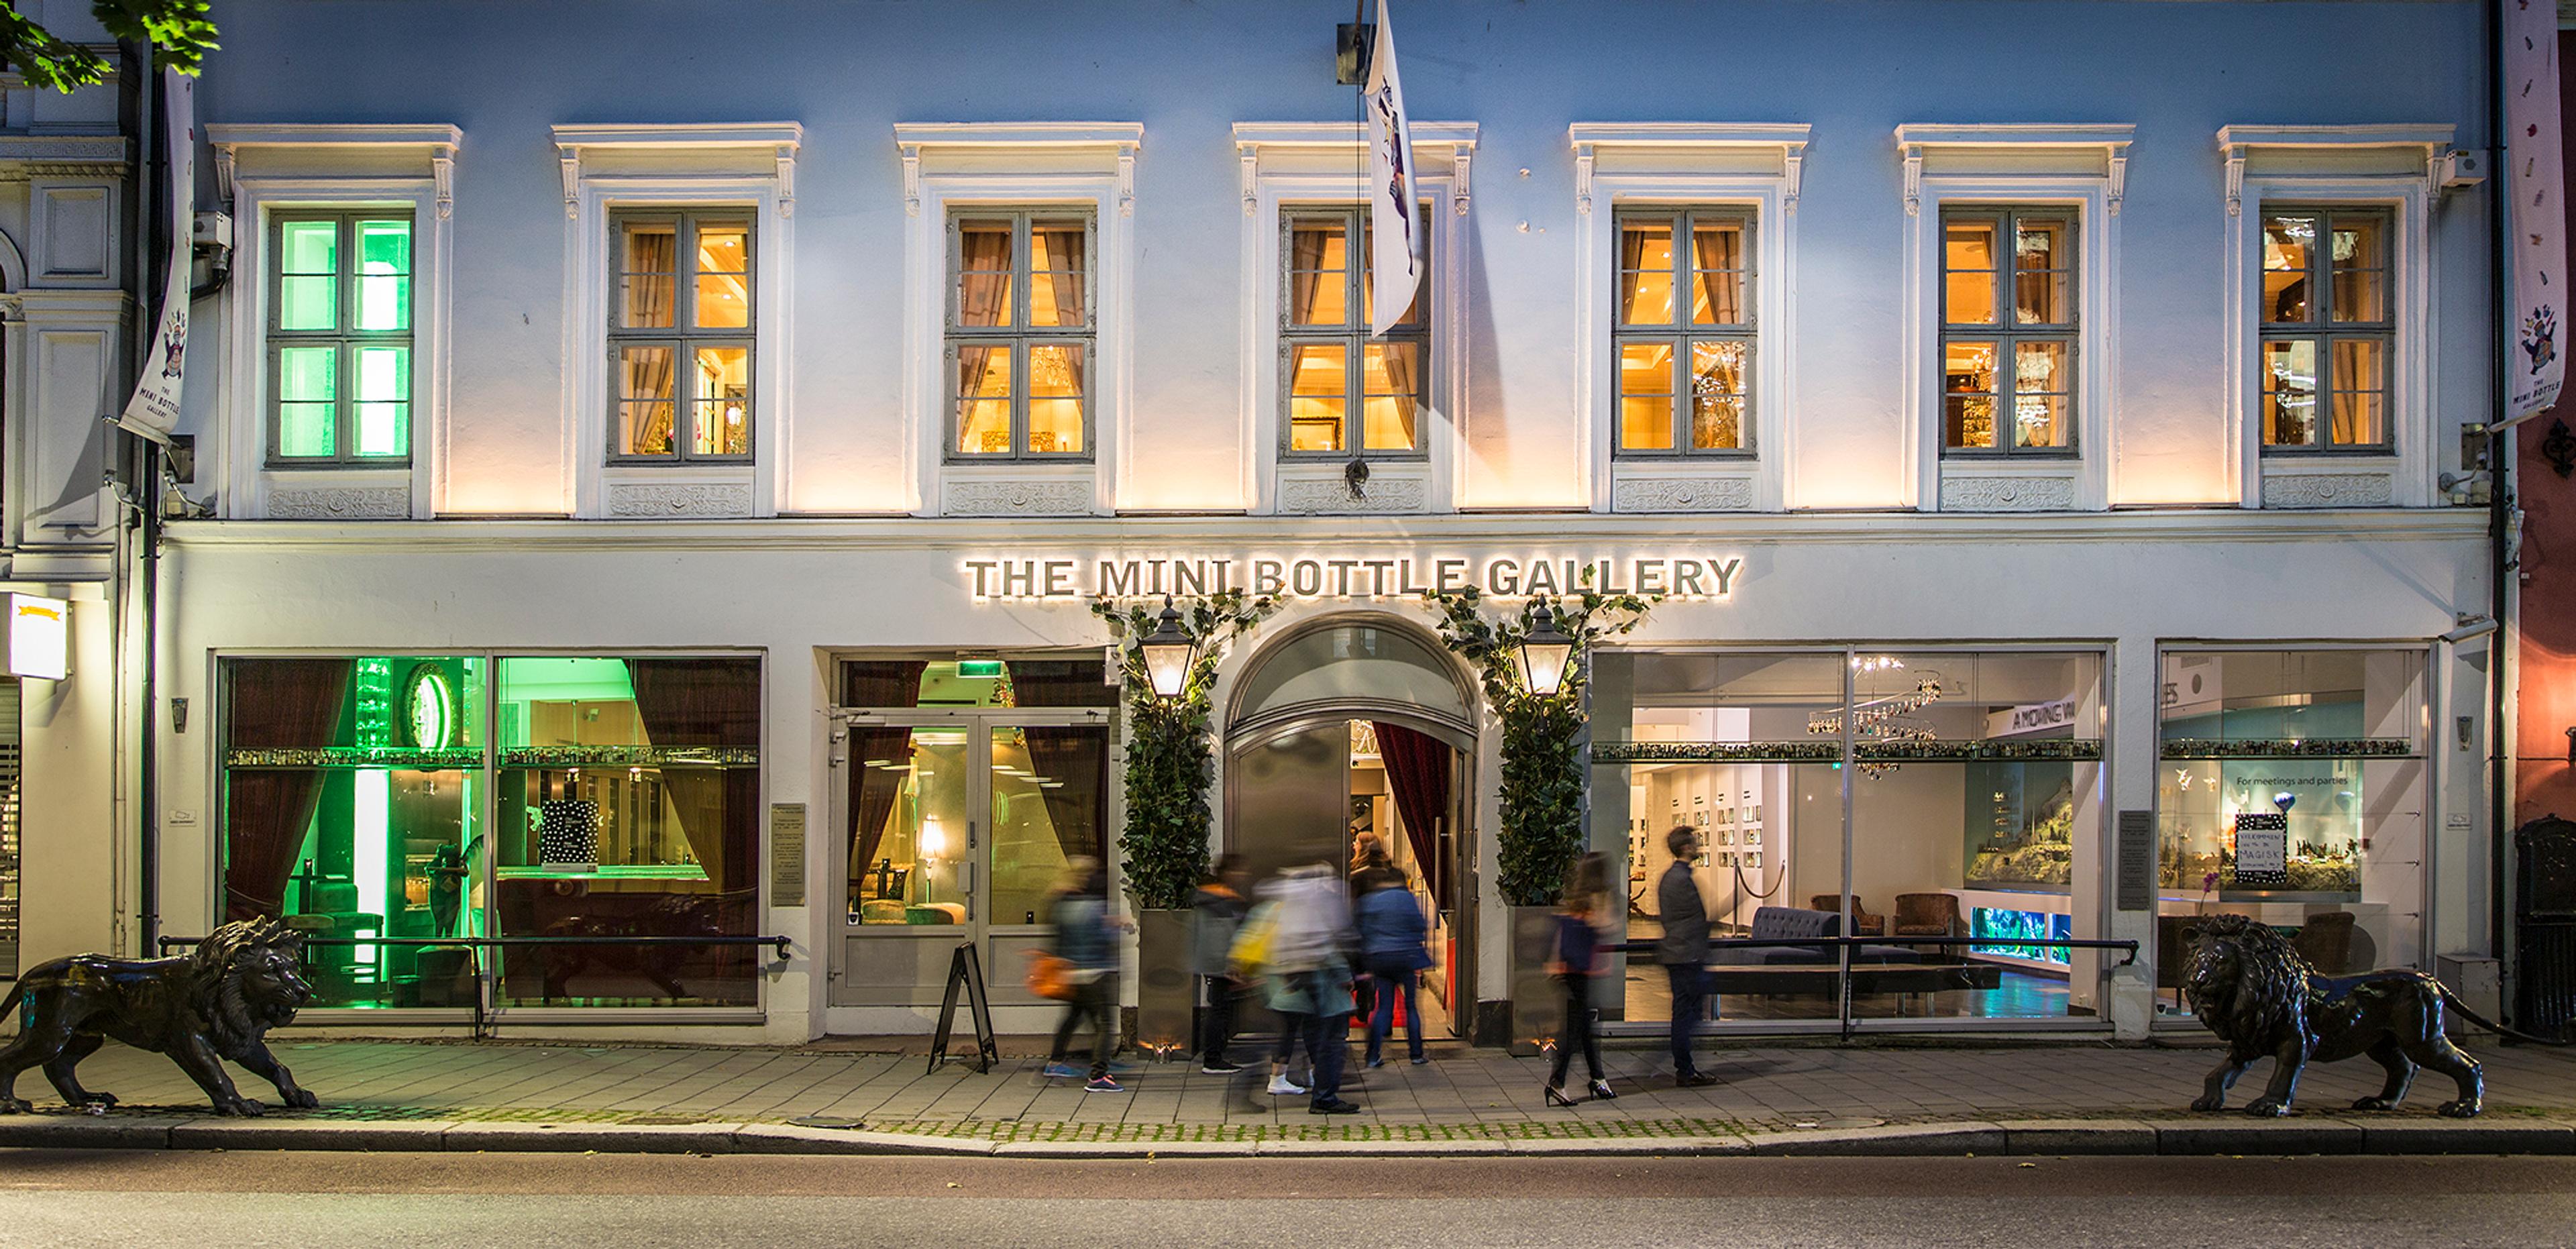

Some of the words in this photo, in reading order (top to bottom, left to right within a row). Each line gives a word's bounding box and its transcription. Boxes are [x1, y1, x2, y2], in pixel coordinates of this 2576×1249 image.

[161, 386, 170, 395] THE
[2513, 392, 2530, 404] MINI
[2533, 380, 2561, 398] BOTTLE
[139, 387, 157, 402] MINI
[158, 396, 180, 415] BOTTLE
[147, 404, 167, 418] GALLERY
[965, 561, 1075, 596] THE
[1101, 559, 1232, 596] MINI
[1254, 559, 1465, 596] BOTTLE
[1488, 558, 1741, 595] GALLERY
[2237, 777, 2251, 785] For
[2253, 775, 2296, 788] meetings
[2298, 776, 2314, 785] and
[2317, 776, 2348, 787] parties
[2239, 849, 2279, 861] MAGISK
